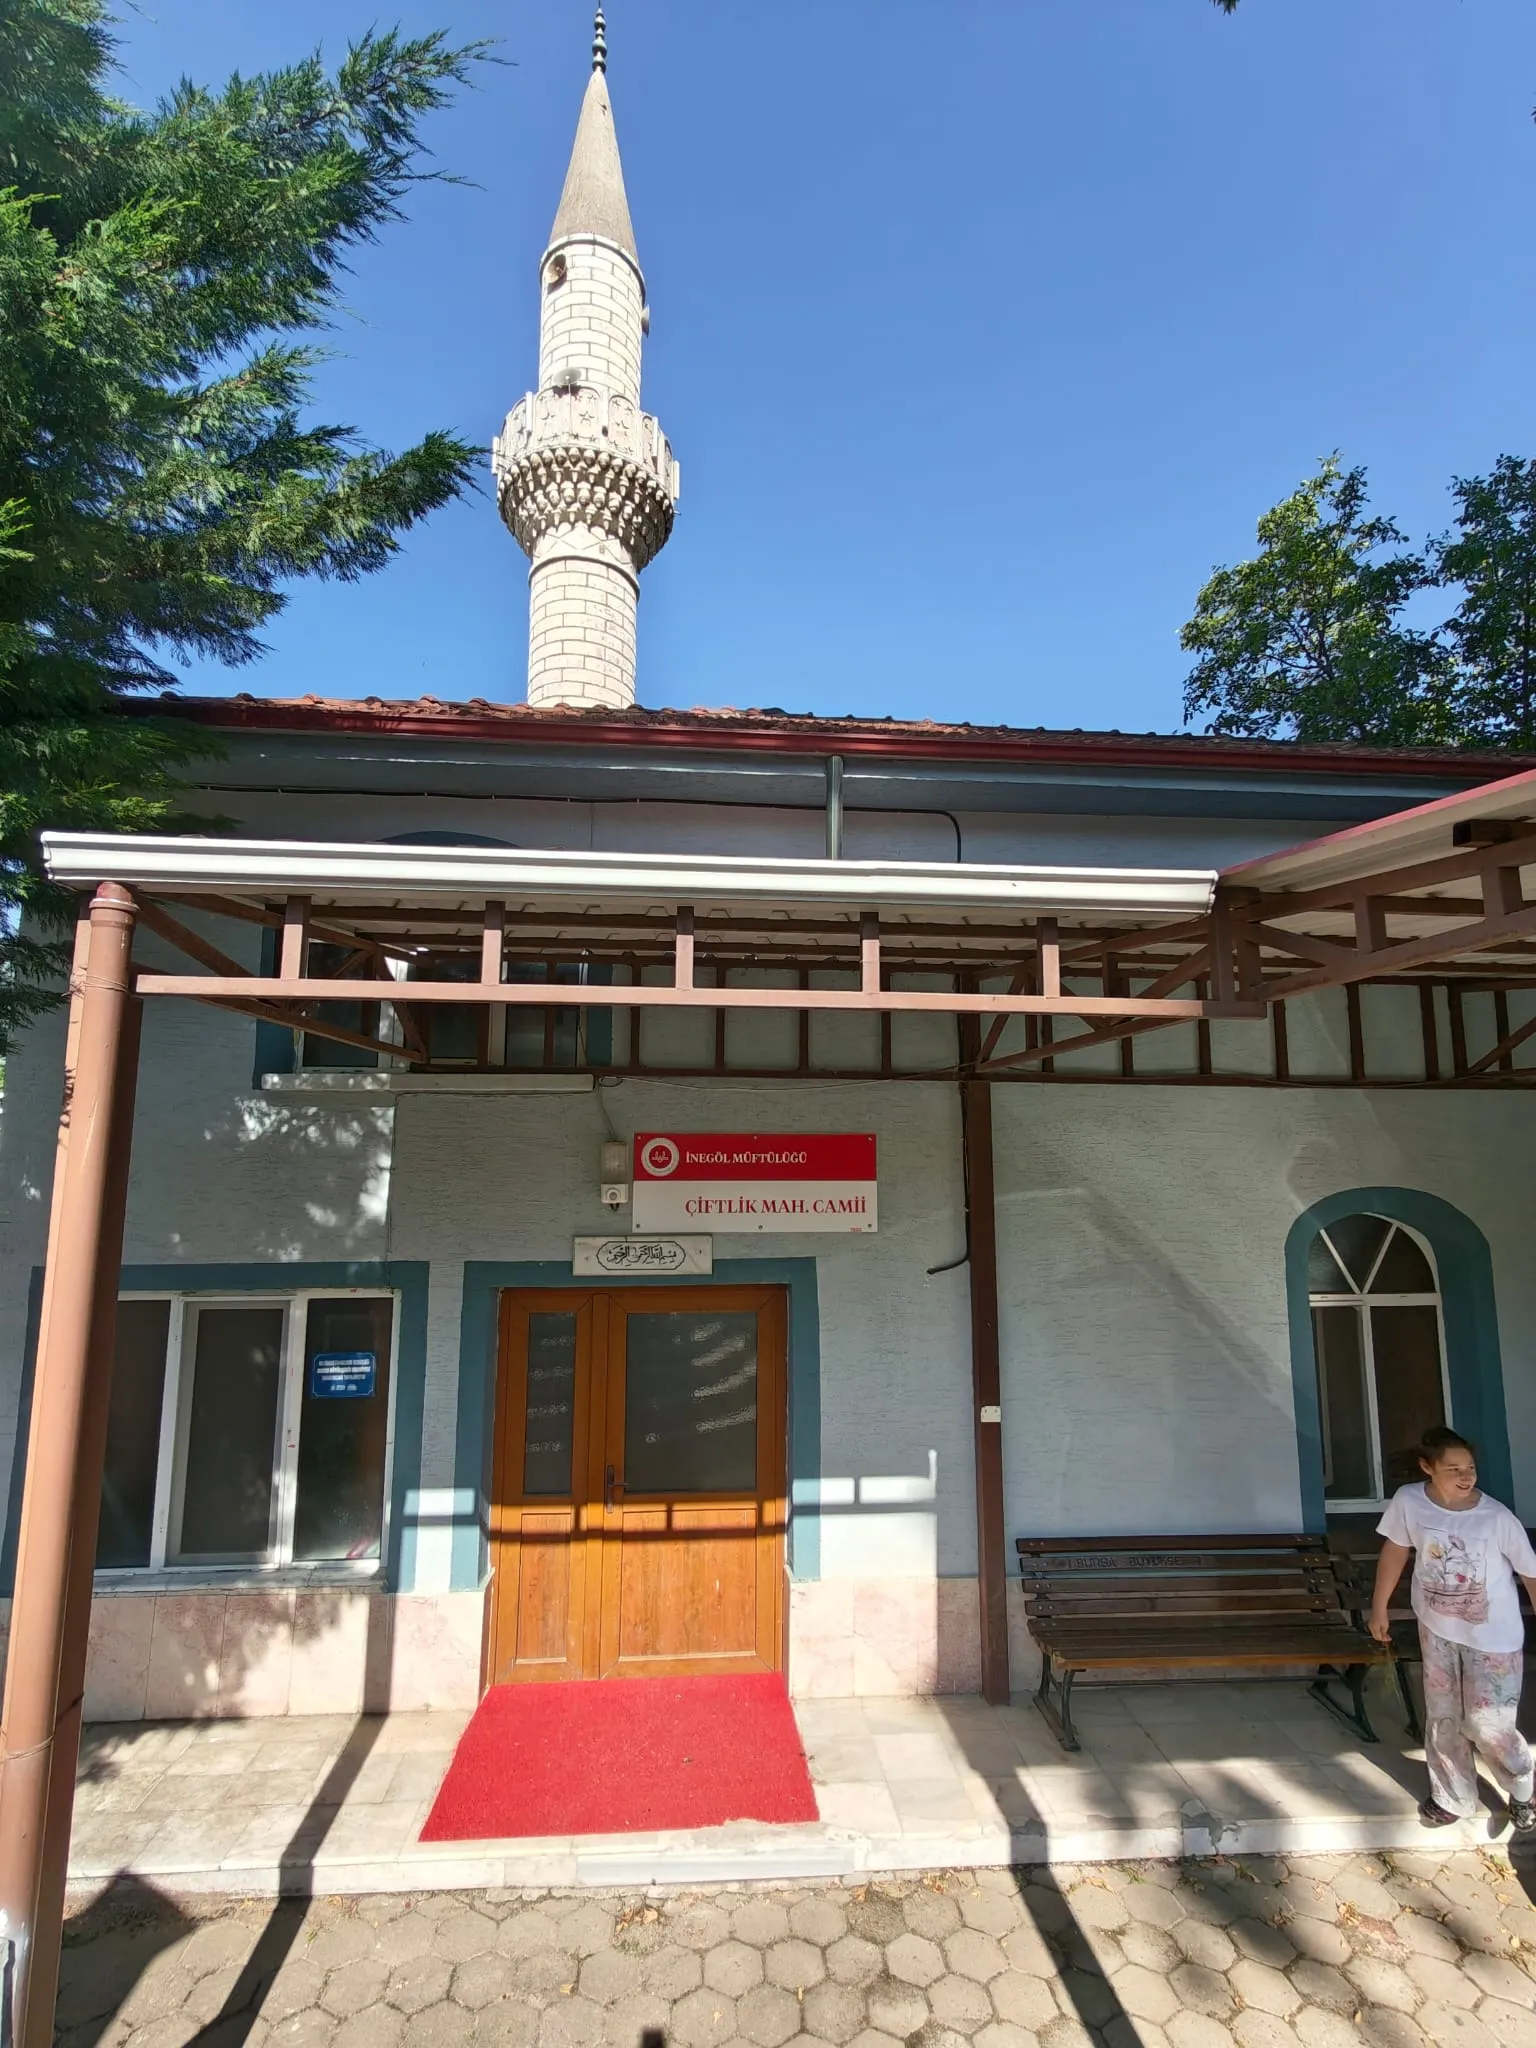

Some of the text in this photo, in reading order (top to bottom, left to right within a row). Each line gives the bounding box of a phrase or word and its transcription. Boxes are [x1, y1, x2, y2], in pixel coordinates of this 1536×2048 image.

[686, 1151, 807, 1163] İNEGÖL MÜFTÜLÜĞÜ
[685, 1196, 867, 1217] ÇİFTLİK MAH. CAMİİ
